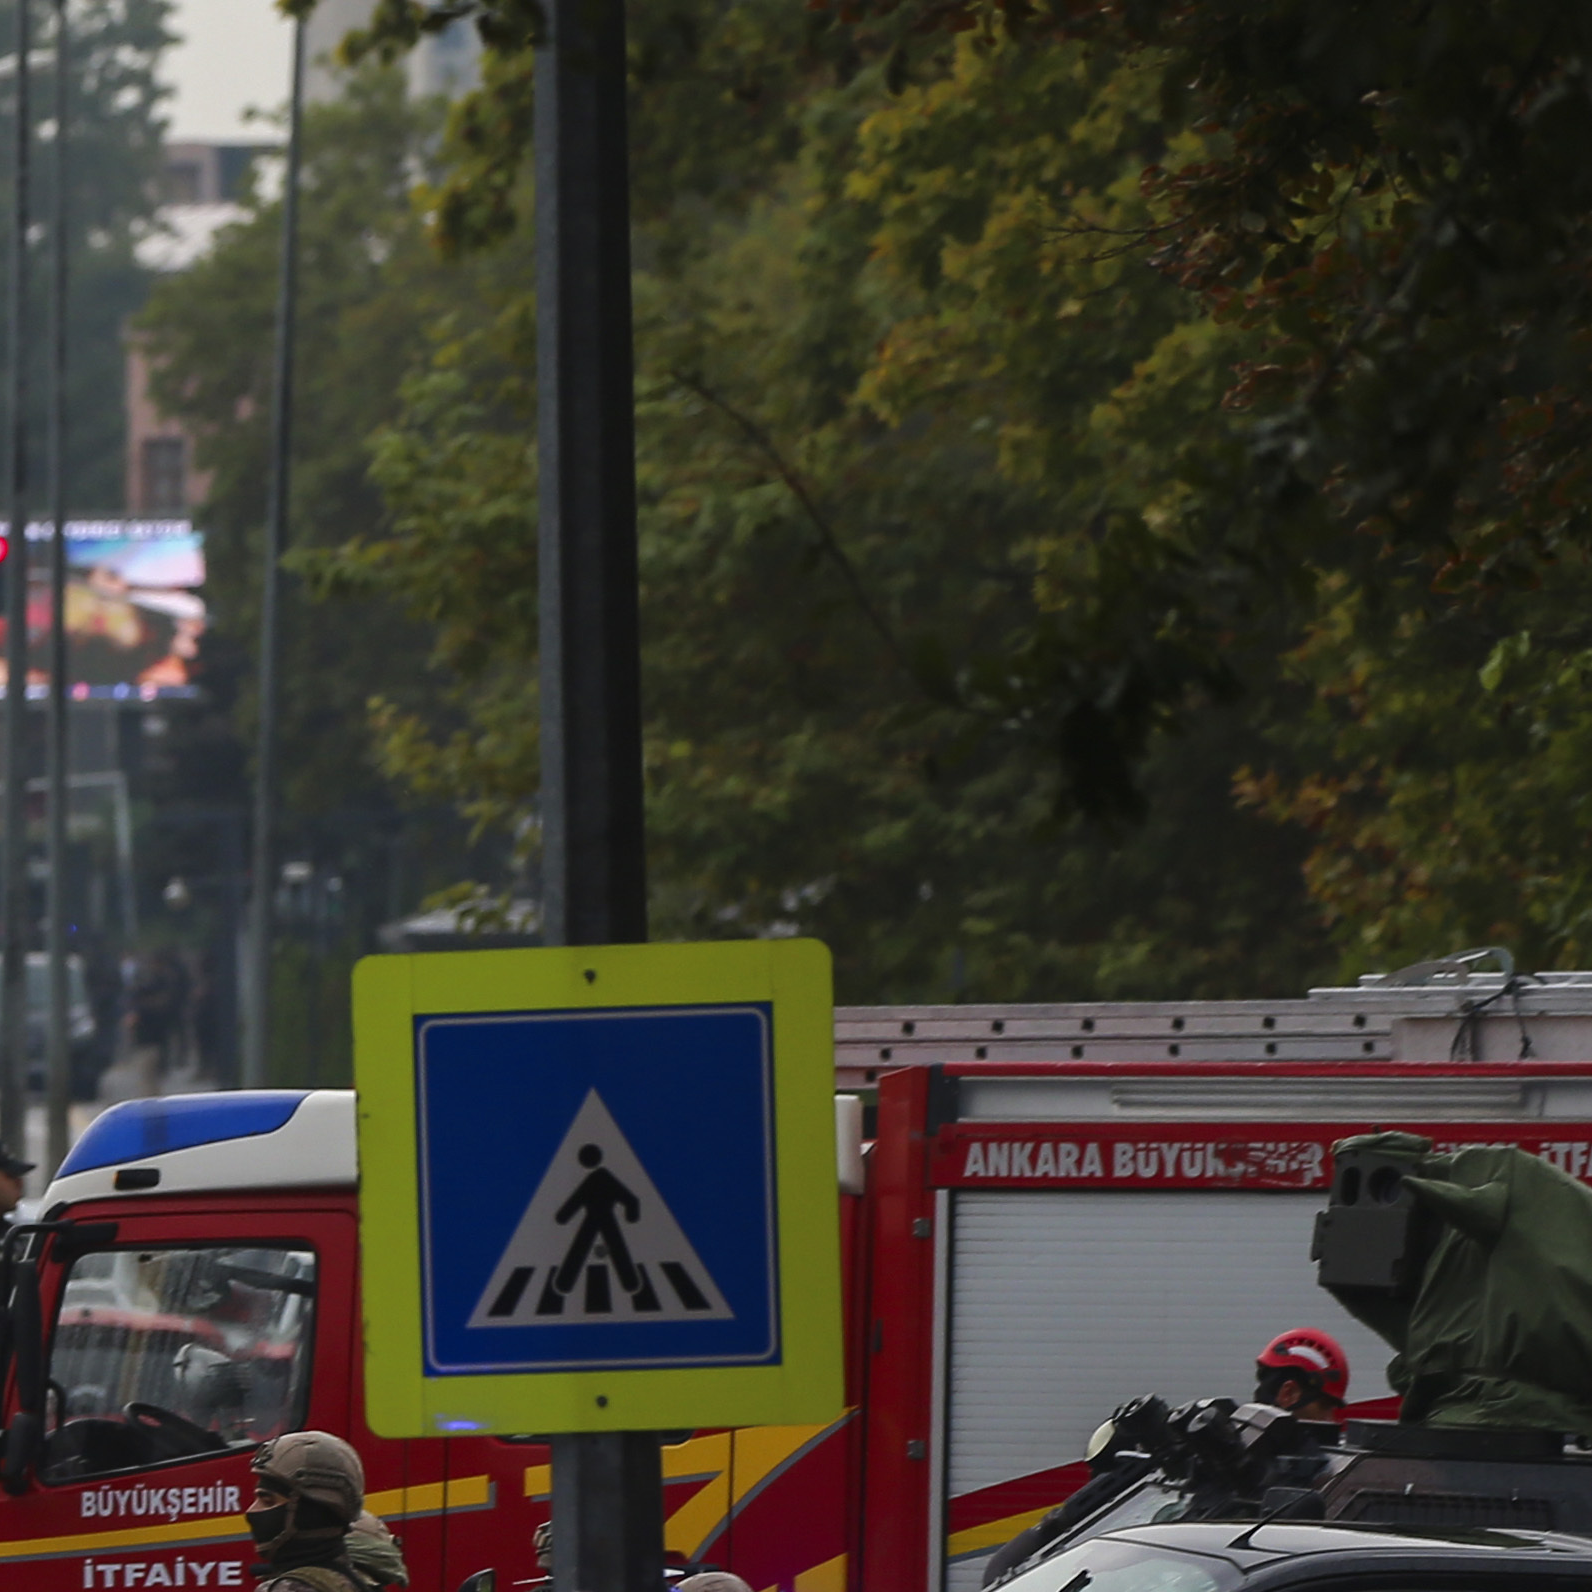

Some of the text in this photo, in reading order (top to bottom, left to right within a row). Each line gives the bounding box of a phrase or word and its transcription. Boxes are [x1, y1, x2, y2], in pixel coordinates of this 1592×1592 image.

[964, 1142, 1102, 1178] ANKARA
[81, 1480, 241, 1522] BÜYÜKŞEHİR
[83, 1556, 244, 1589] İTFAİYE
